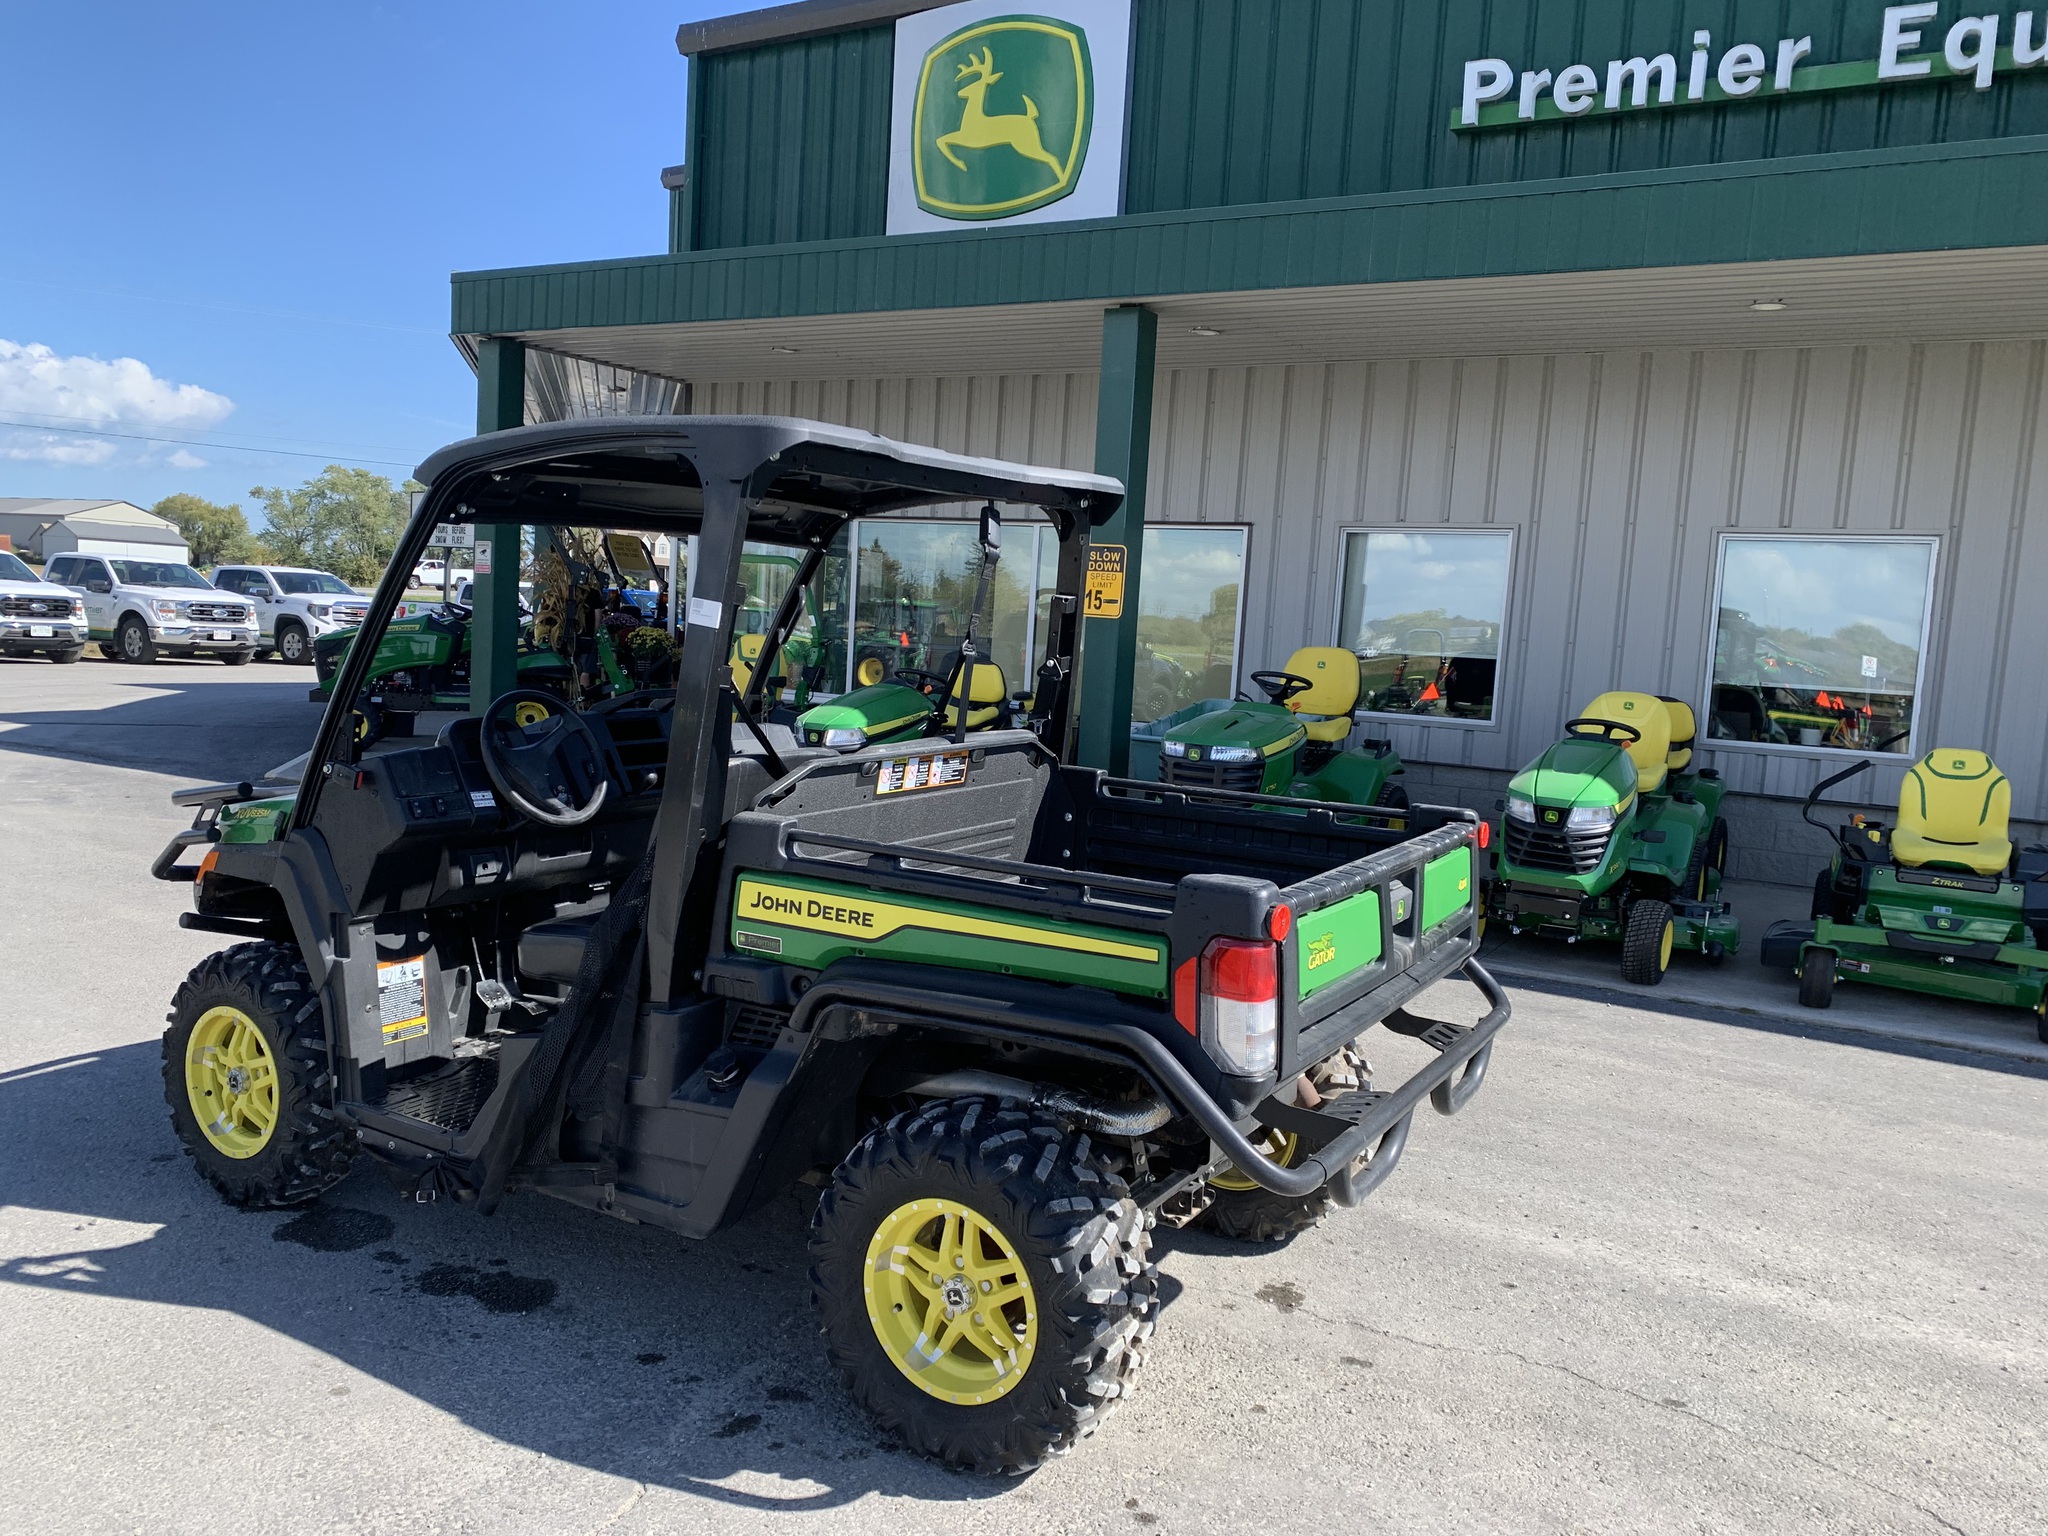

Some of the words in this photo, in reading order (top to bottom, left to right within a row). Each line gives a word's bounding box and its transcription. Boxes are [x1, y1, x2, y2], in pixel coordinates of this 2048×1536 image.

[1460, 29, 1811, 127] Premier
[1089, 551, 1121, 562] SLOW
[1087, 561, 1121, 572] DOWN
[1090, 572, 1117, 581] SPEED
[1085, 588, 1103, 611] 15
[1931, 877, 1965, 888] ZTRAK
[750, 891, 802, 916] JOHN
[806, 900, 874, 928] DEERE
[748, 936, 780, 948] Premier
[1308, 946, 1336, 971] GATOR
